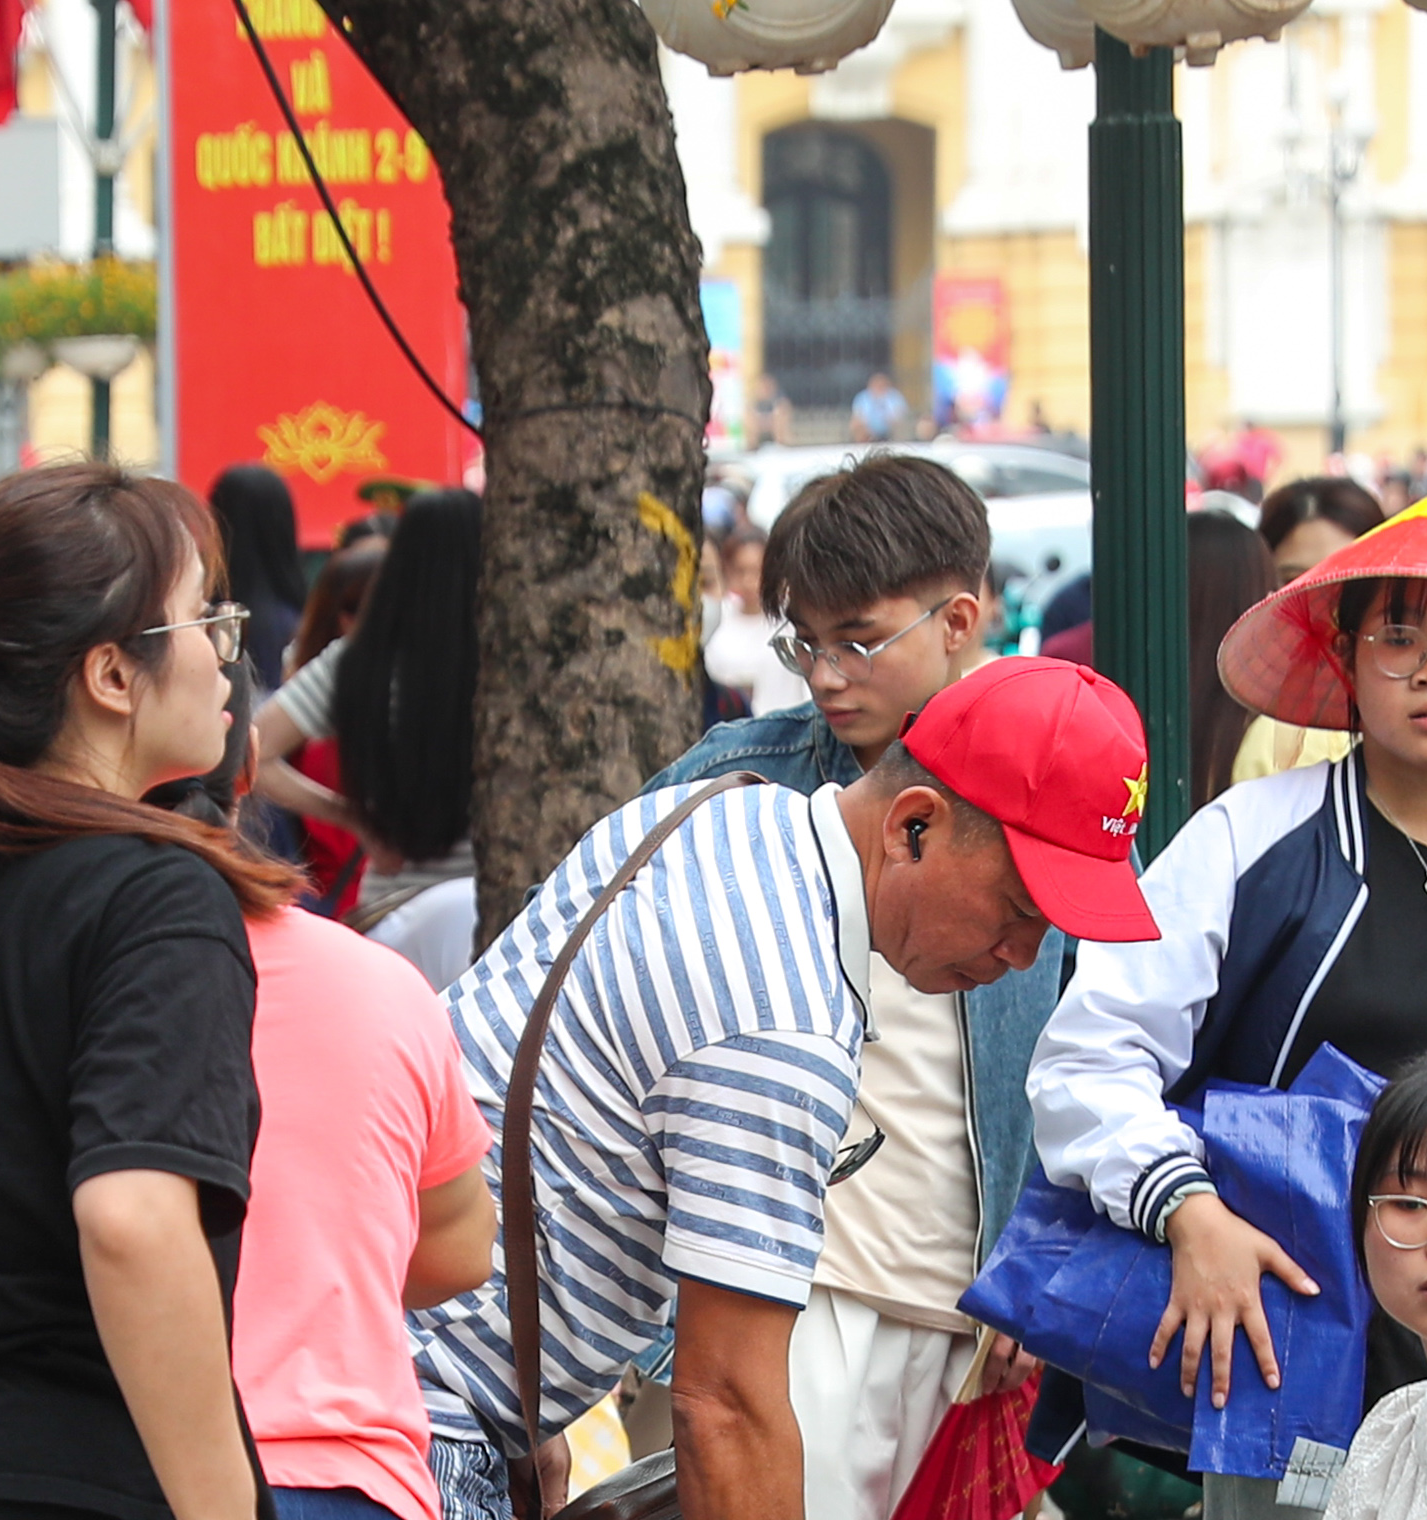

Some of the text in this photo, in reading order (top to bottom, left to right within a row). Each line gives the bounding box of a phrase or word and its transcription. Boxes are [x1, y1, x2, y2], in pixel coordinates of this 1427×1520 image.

[195, 120, 271, 190] QUỐC
[375, 128, 428, 183] 2-9
[253, 199, 308, 267] BẤT
